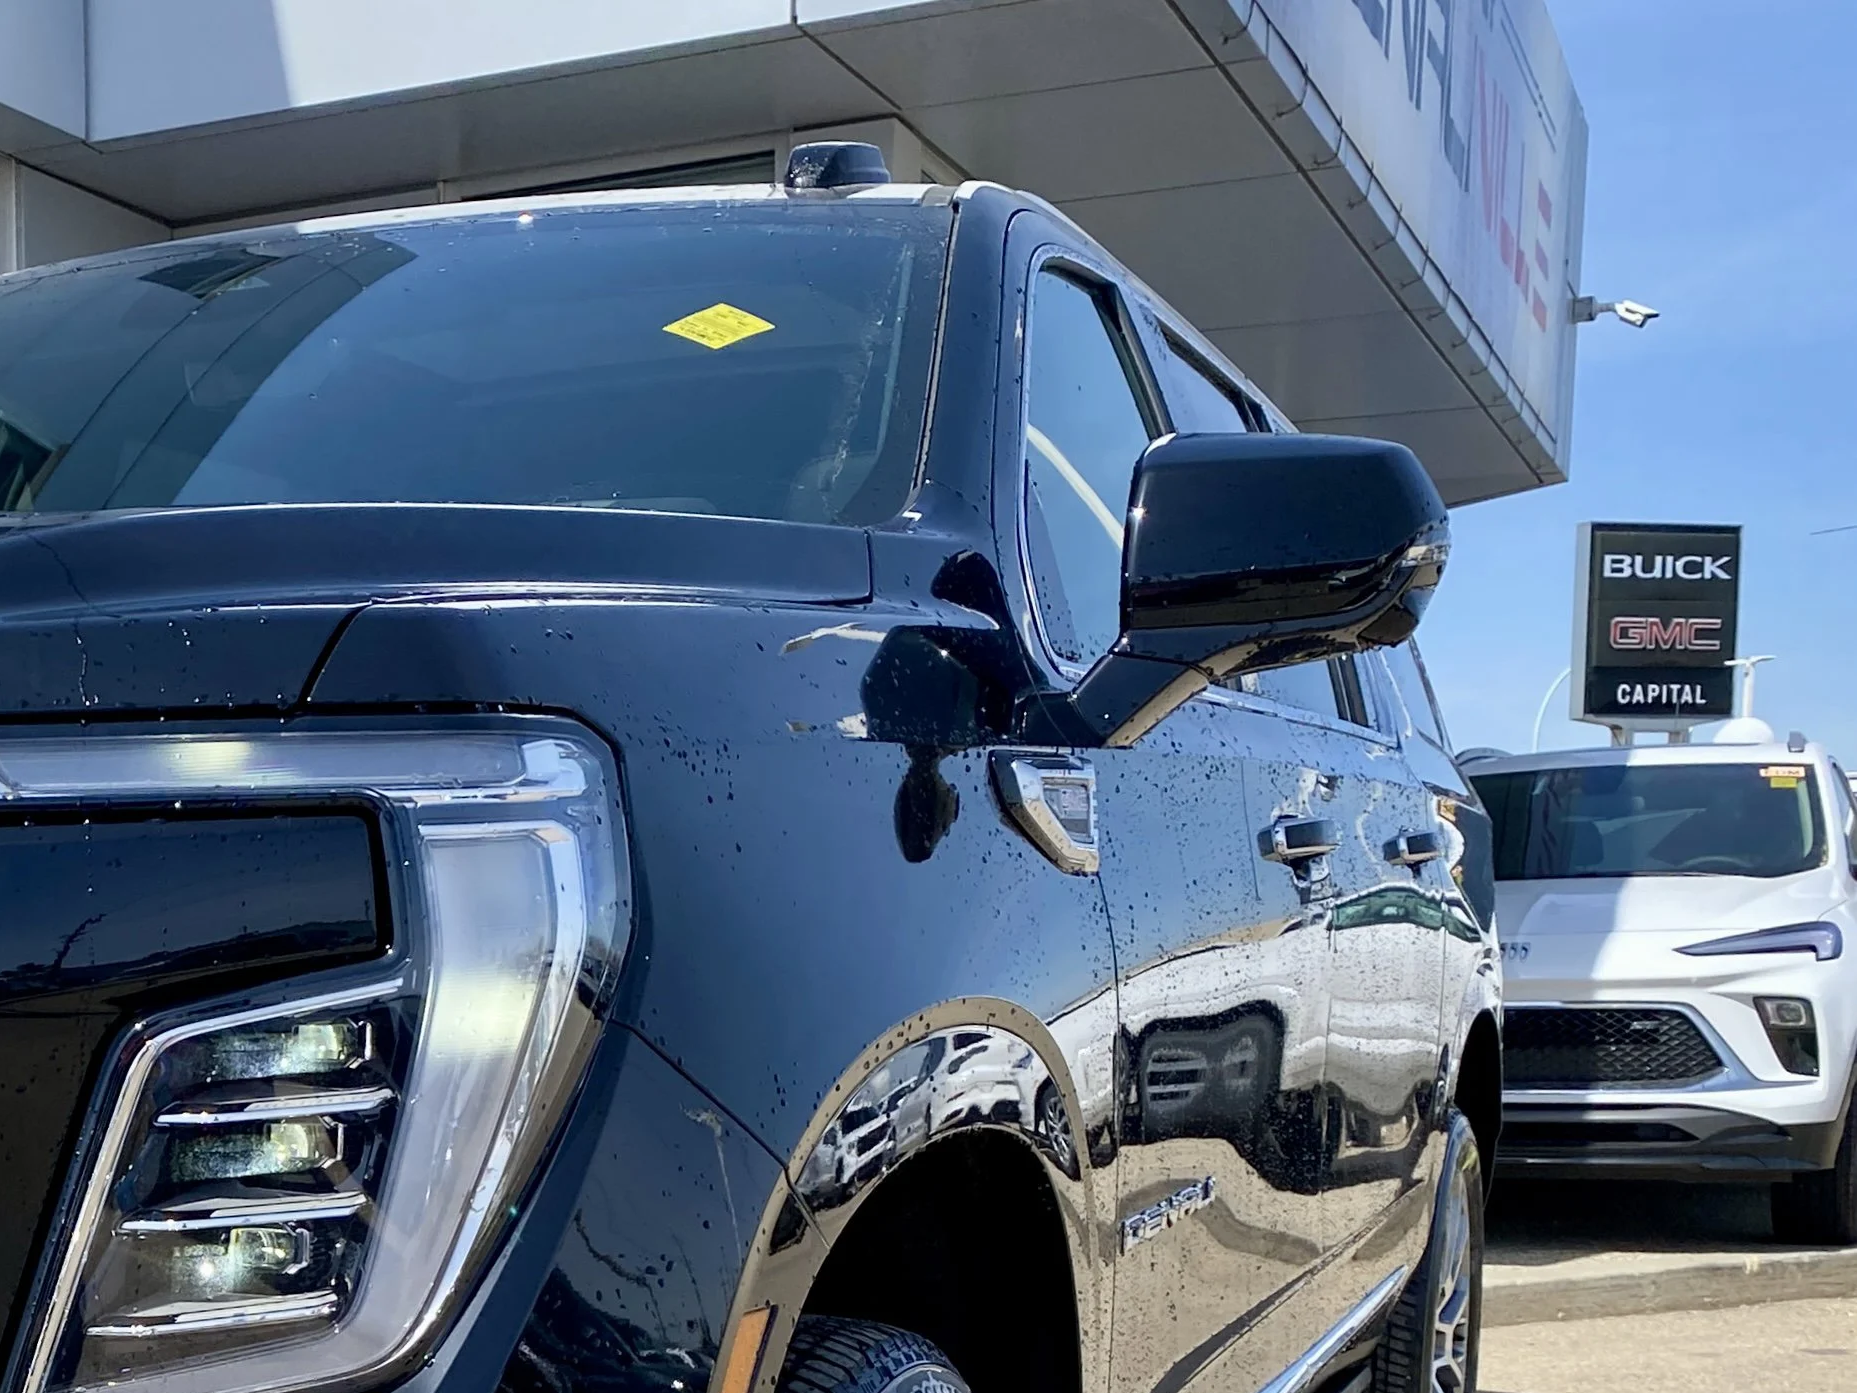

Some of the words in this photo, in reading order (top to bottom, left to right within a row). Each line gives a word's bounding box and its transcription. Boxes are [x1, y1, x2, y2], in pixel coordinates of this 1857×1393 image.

[1603, 554, 1732, 580] BUICK
[1610, 616, 1722, 650] GMC
[1617, 683, 1707, 704] CAPITAL
